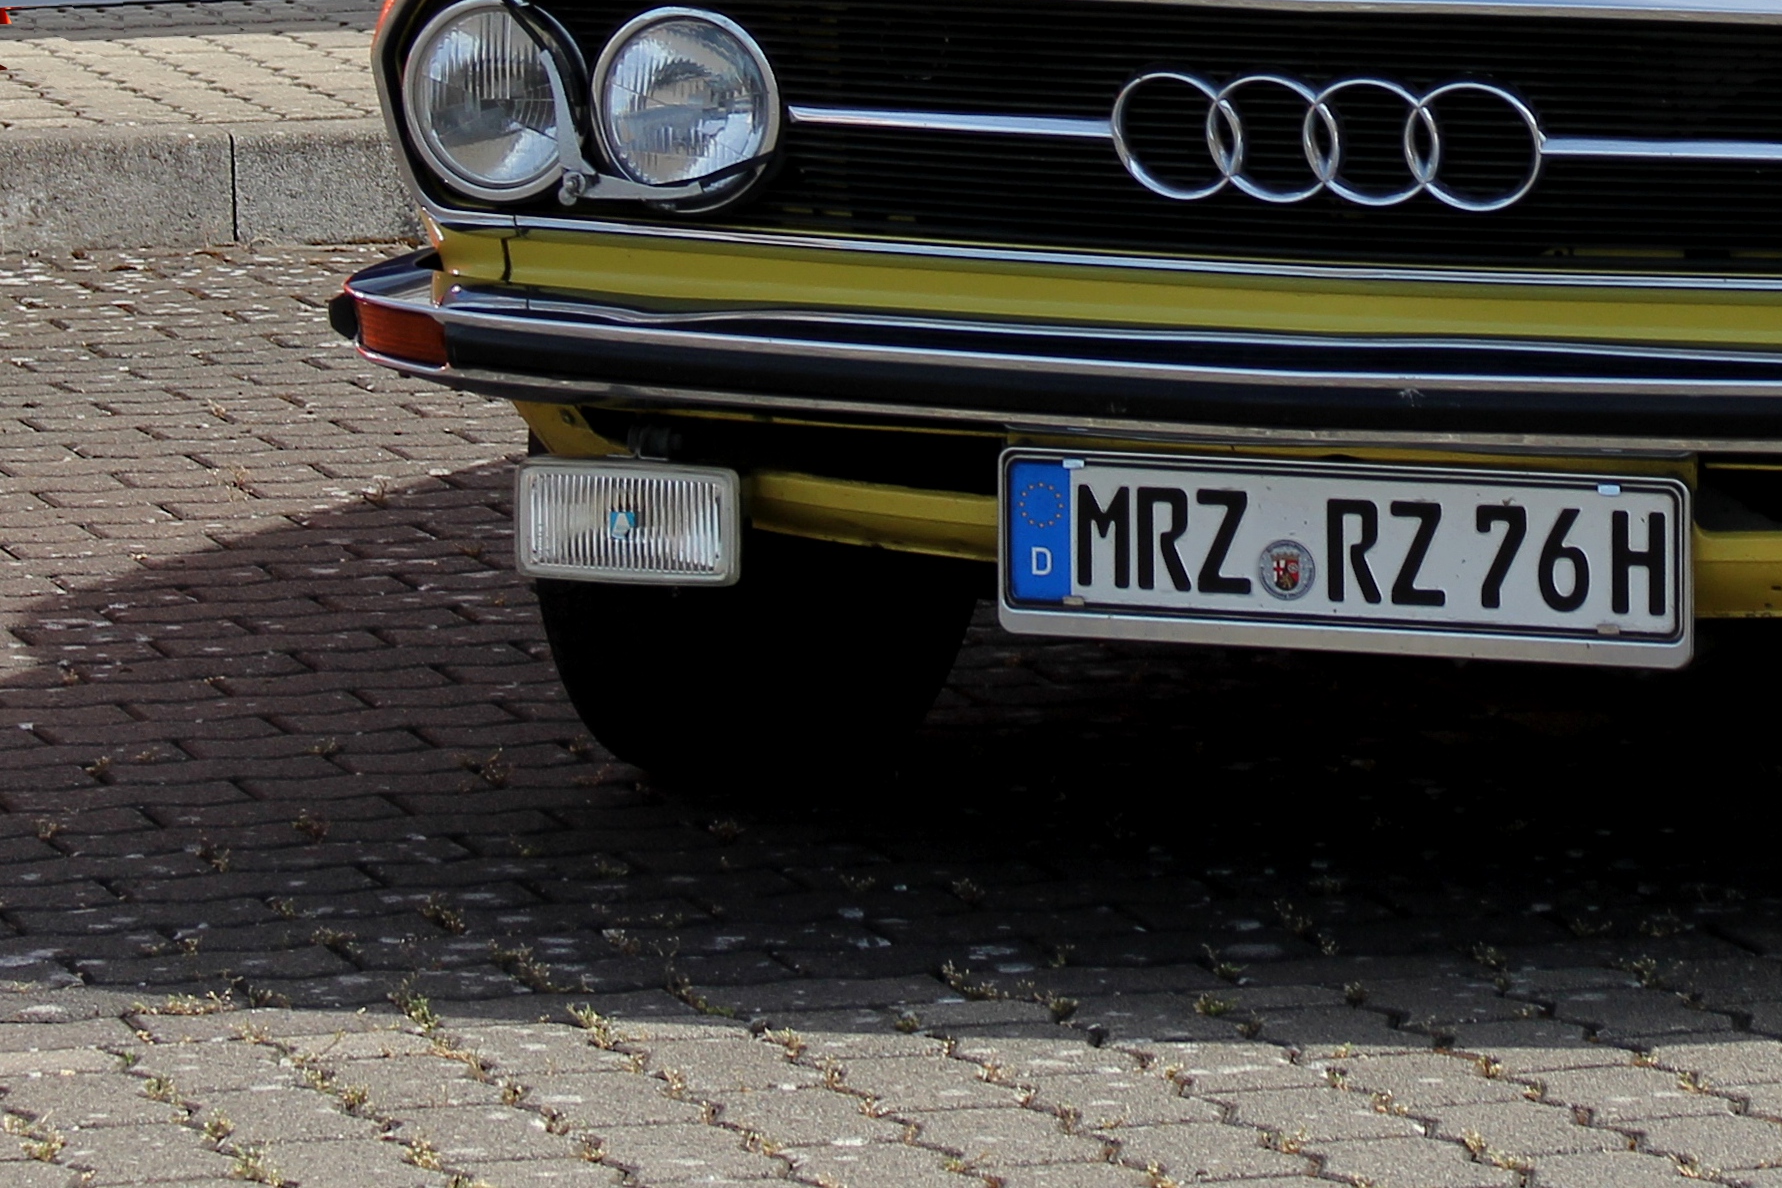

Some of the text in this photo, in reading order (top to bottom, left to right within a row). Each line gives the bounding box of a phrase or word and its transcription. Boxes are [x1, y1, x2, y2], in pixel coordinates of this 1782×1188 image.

[1031, 546, 1053, 575] D
[1077, 483, 1252, 596] MRZ
[1326, 498, 1446, 607] RZ
[1475, 504, 1667, 616] 76H
